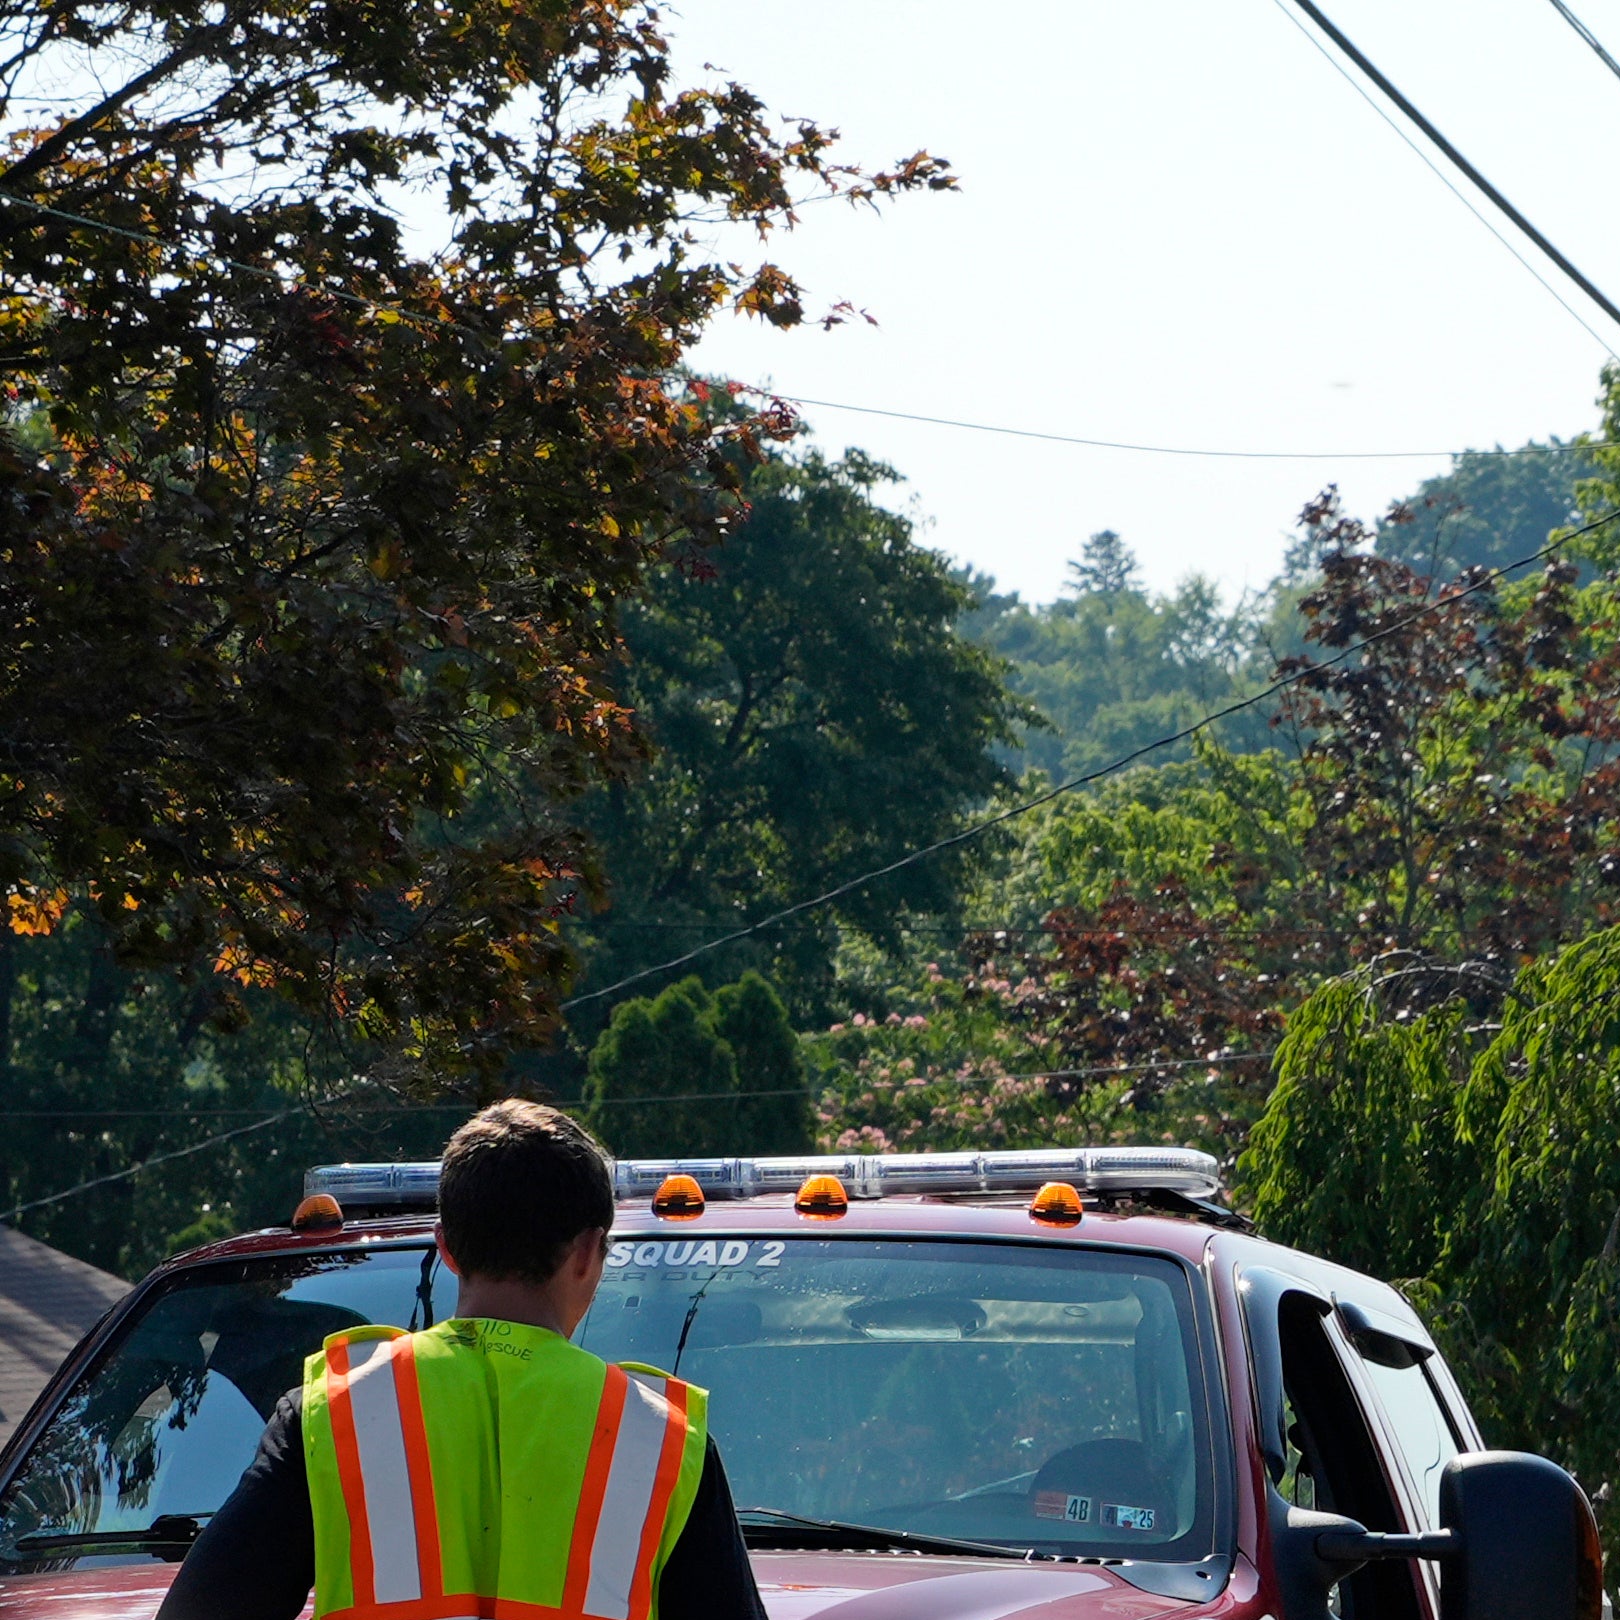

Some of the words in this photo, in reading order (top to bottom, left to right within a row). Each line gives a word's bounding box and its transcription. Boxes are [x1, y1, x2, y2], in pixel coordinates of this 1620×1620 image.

[605, 1240, 749, 1268] SQUAD
[756, 1240, 786, 1267] 2
[660, 1270, 777, 1282] DUTY
[1139, 1509, 1154, 1529] 25
